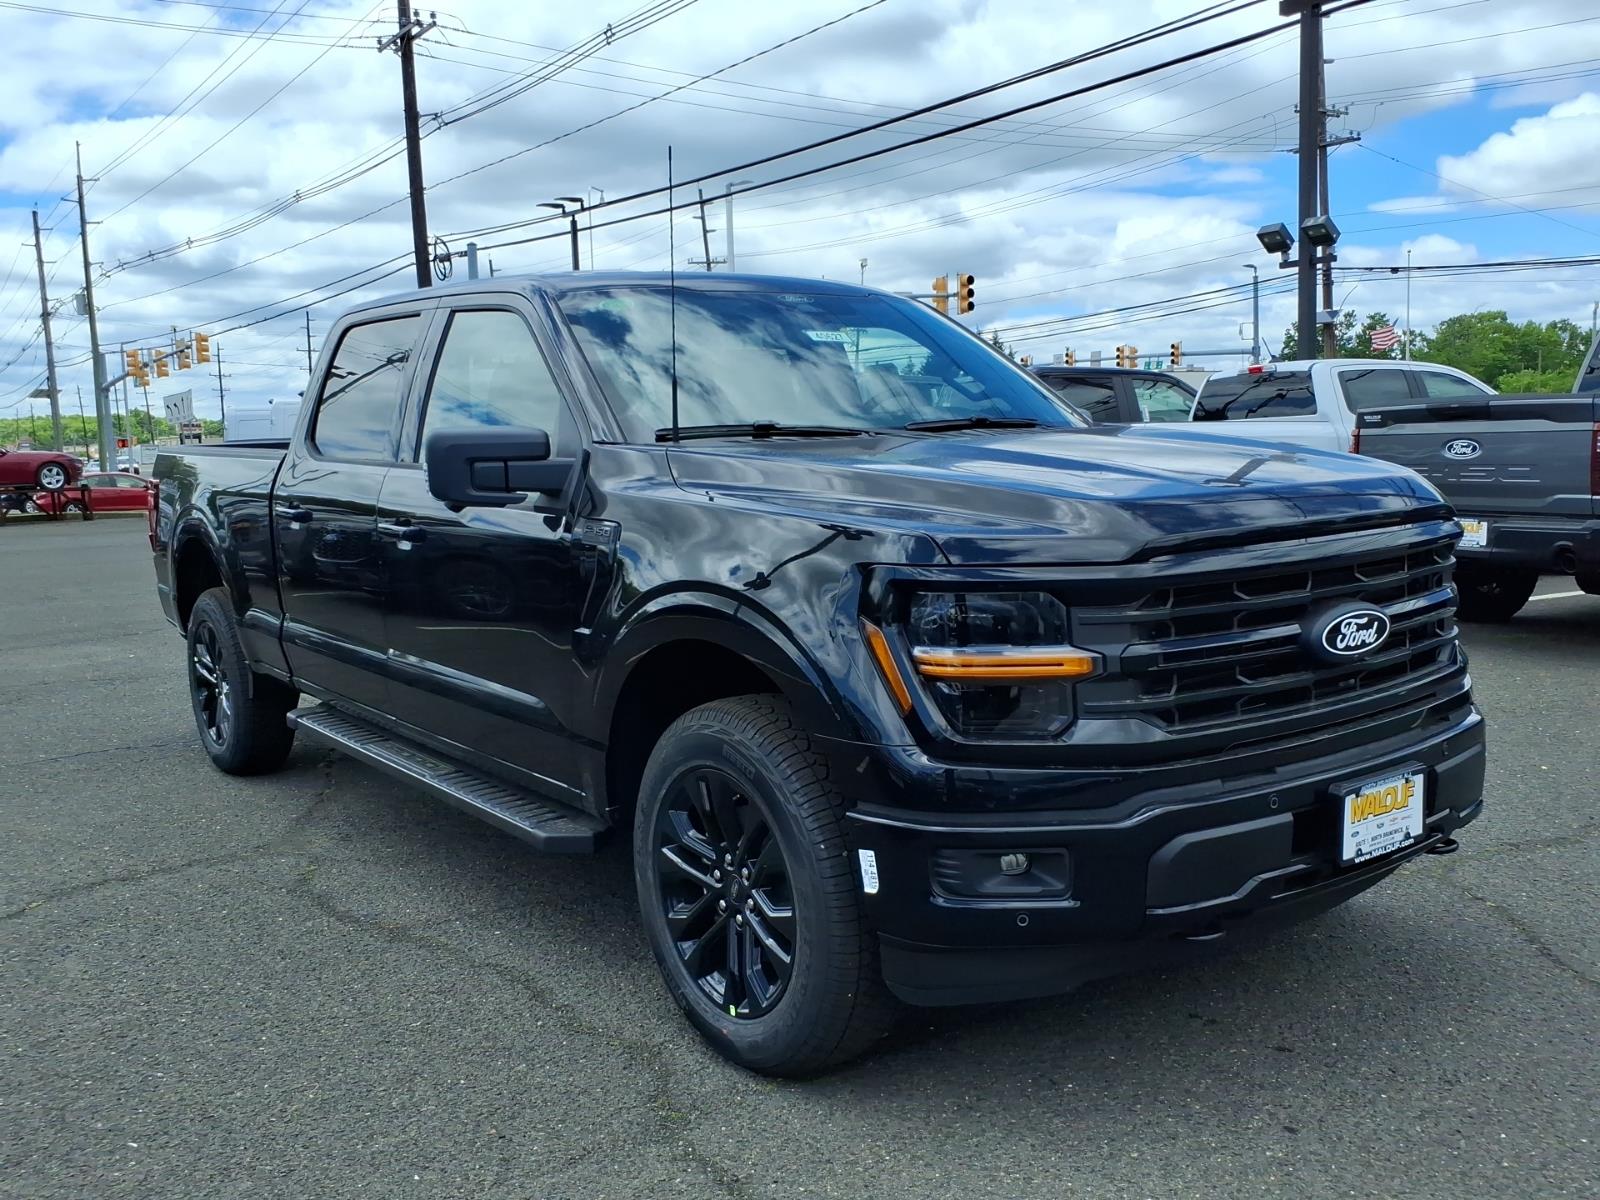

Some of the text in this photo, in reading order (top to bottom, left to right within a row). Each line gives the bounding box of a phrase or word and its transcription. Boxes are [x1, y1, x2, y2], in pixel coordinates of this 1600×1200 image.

[1450, 442, 1474, 454] Ford
[1336, 617, 1379, 649] Ford
[1351, 779, 1415, 825] MALOUF
[1354, 838, 1415, 864] www.MALOUF.com
